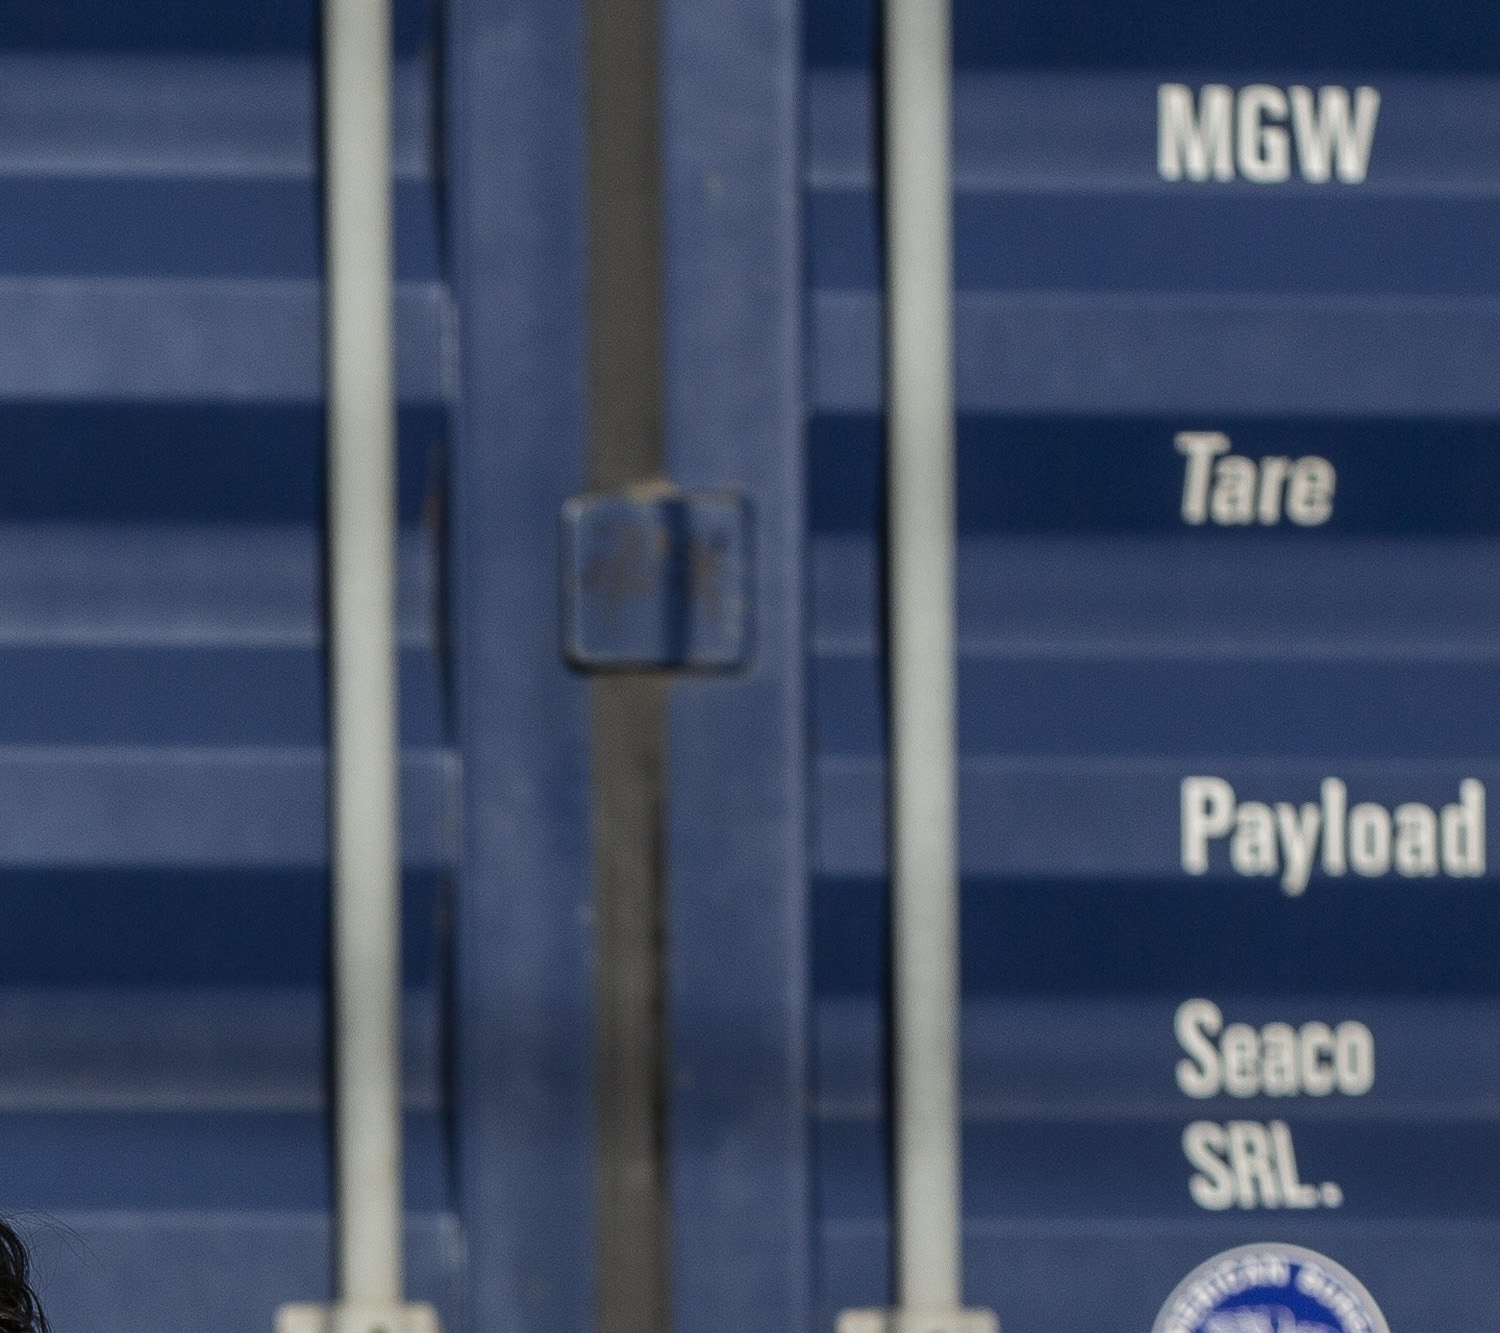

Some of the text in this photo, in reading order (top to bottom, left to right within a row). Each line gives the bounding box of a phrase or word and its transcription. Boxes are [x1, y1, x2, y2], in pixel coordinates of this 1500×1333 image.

[1157, 84, 1380, 184] MGW
[1176, 432, 1336, 524] Tare
[1180, 776, 1487, 893] Payload
[1175, 1000, 1375, 1097] Seaco
[1183, 1121, 1342, 1209] SRL.
